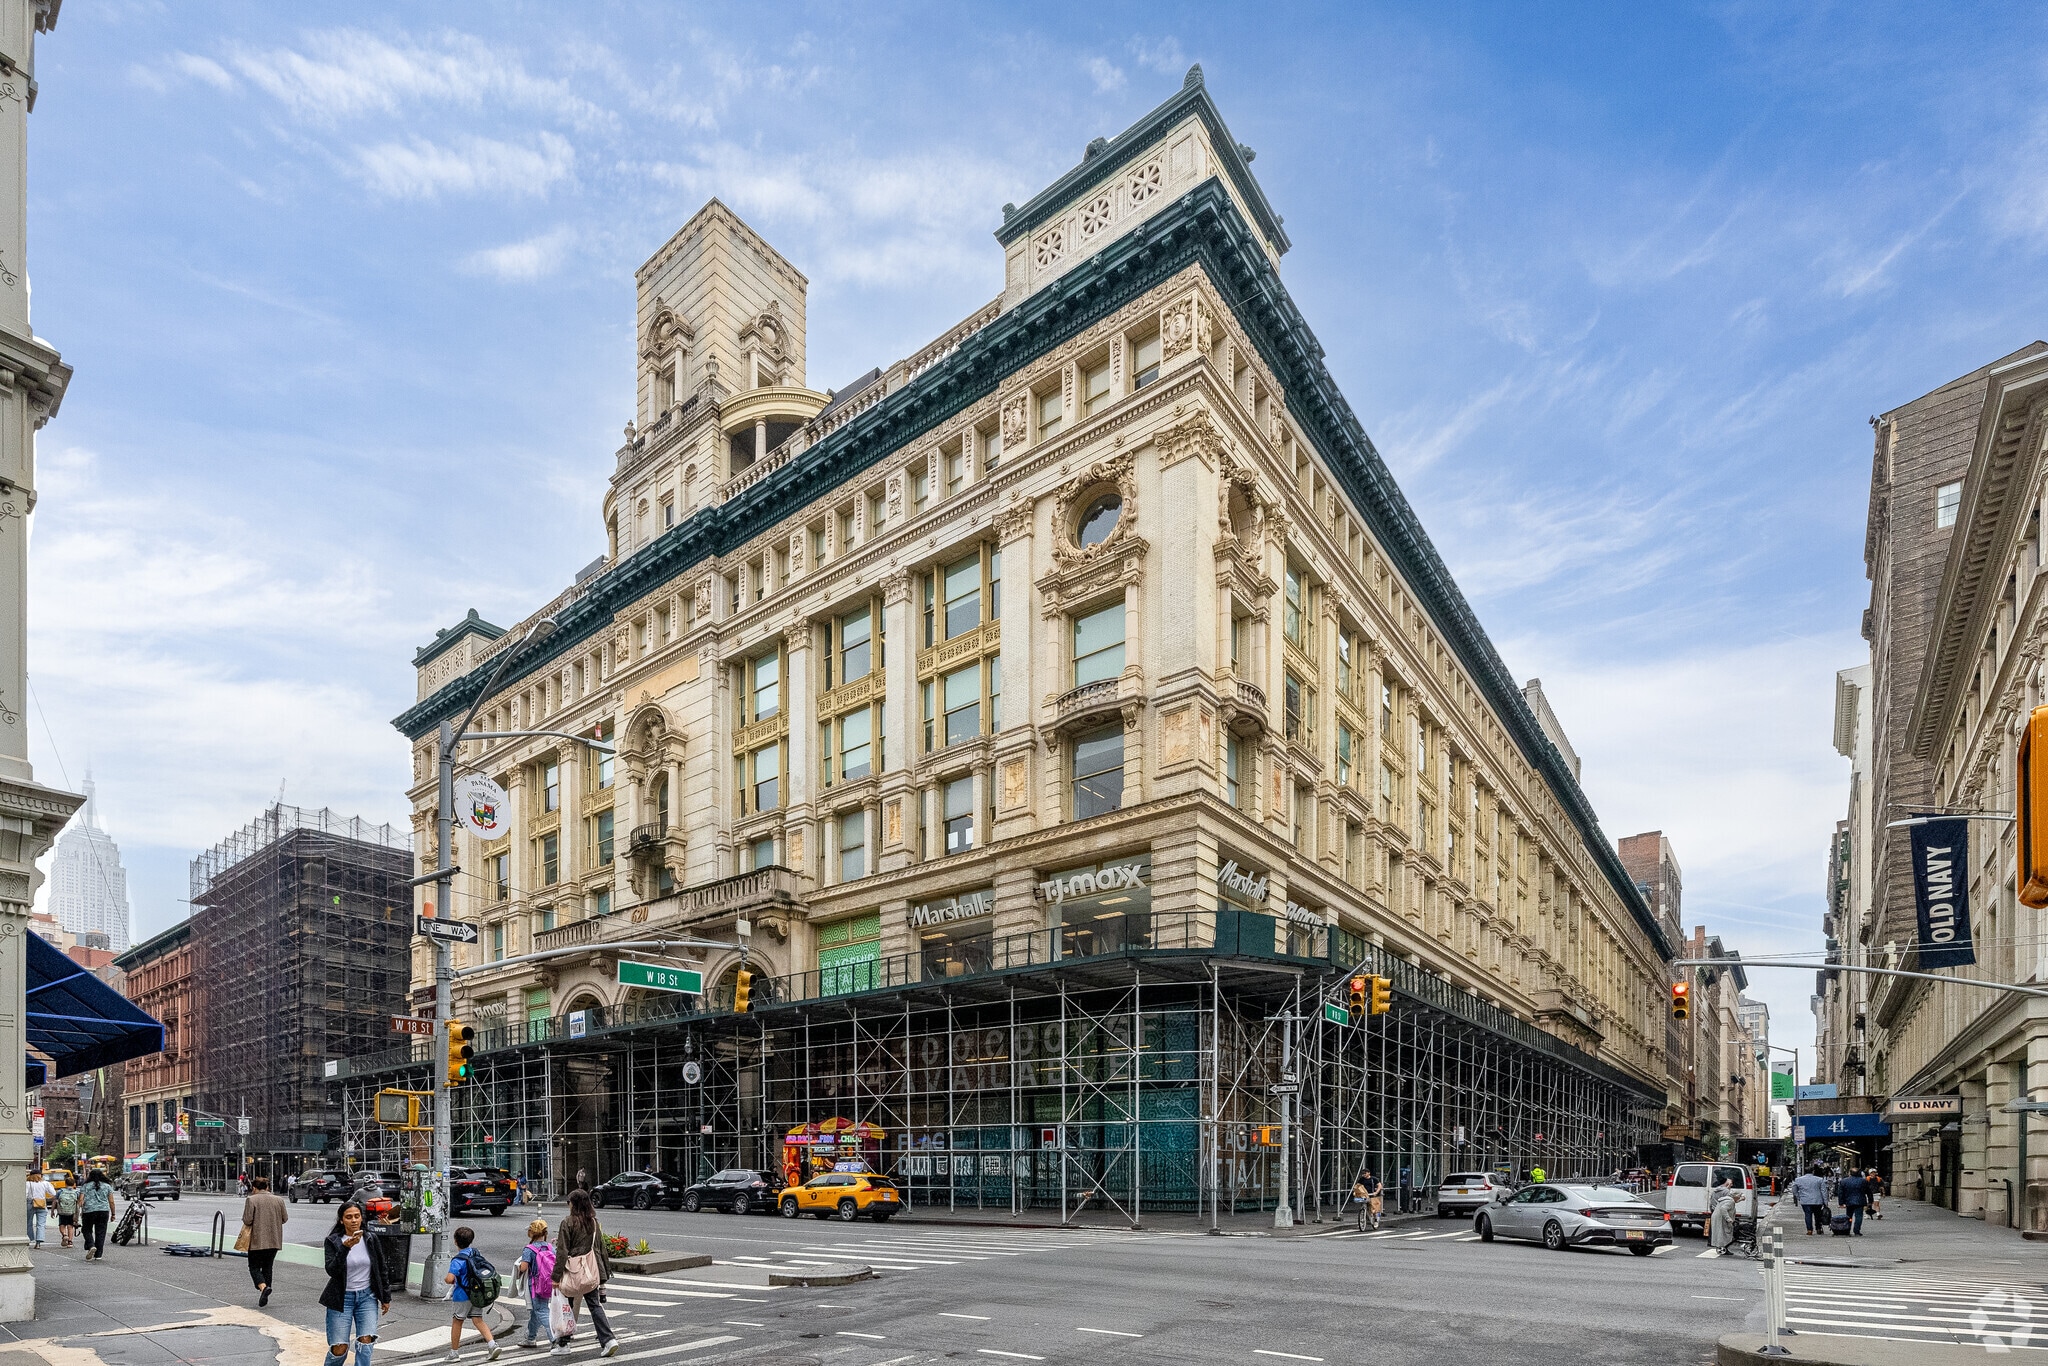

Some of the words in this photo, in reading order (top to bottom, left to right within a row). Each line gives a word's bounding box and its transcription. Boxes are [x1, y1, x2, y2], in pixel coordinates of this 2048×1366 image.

[471, 780, 497, 793] PANAMA
[1217, 859, 1267, 900] Marshalls
[1926, 846, 1953, 900] NAVY
[631, 905, 649, 924] 620
[912, 893, 993, 928] Marshalls
[451, 926, 470, 937] WAY
[1929, 903, 1955, 943] OLD
[646, 970, 654, 983] W
[657, 972, 666, 985] 18
[668, 974, 678, 987] St
[395, 1019, 404, 1031] W
[407, 1021, 417, 1032] 18
[420, 1022, 430, 1034] St
[1899, 1101, 1920, 1110] OLD
[1923, 1100, 1953, 1109] NAVY
